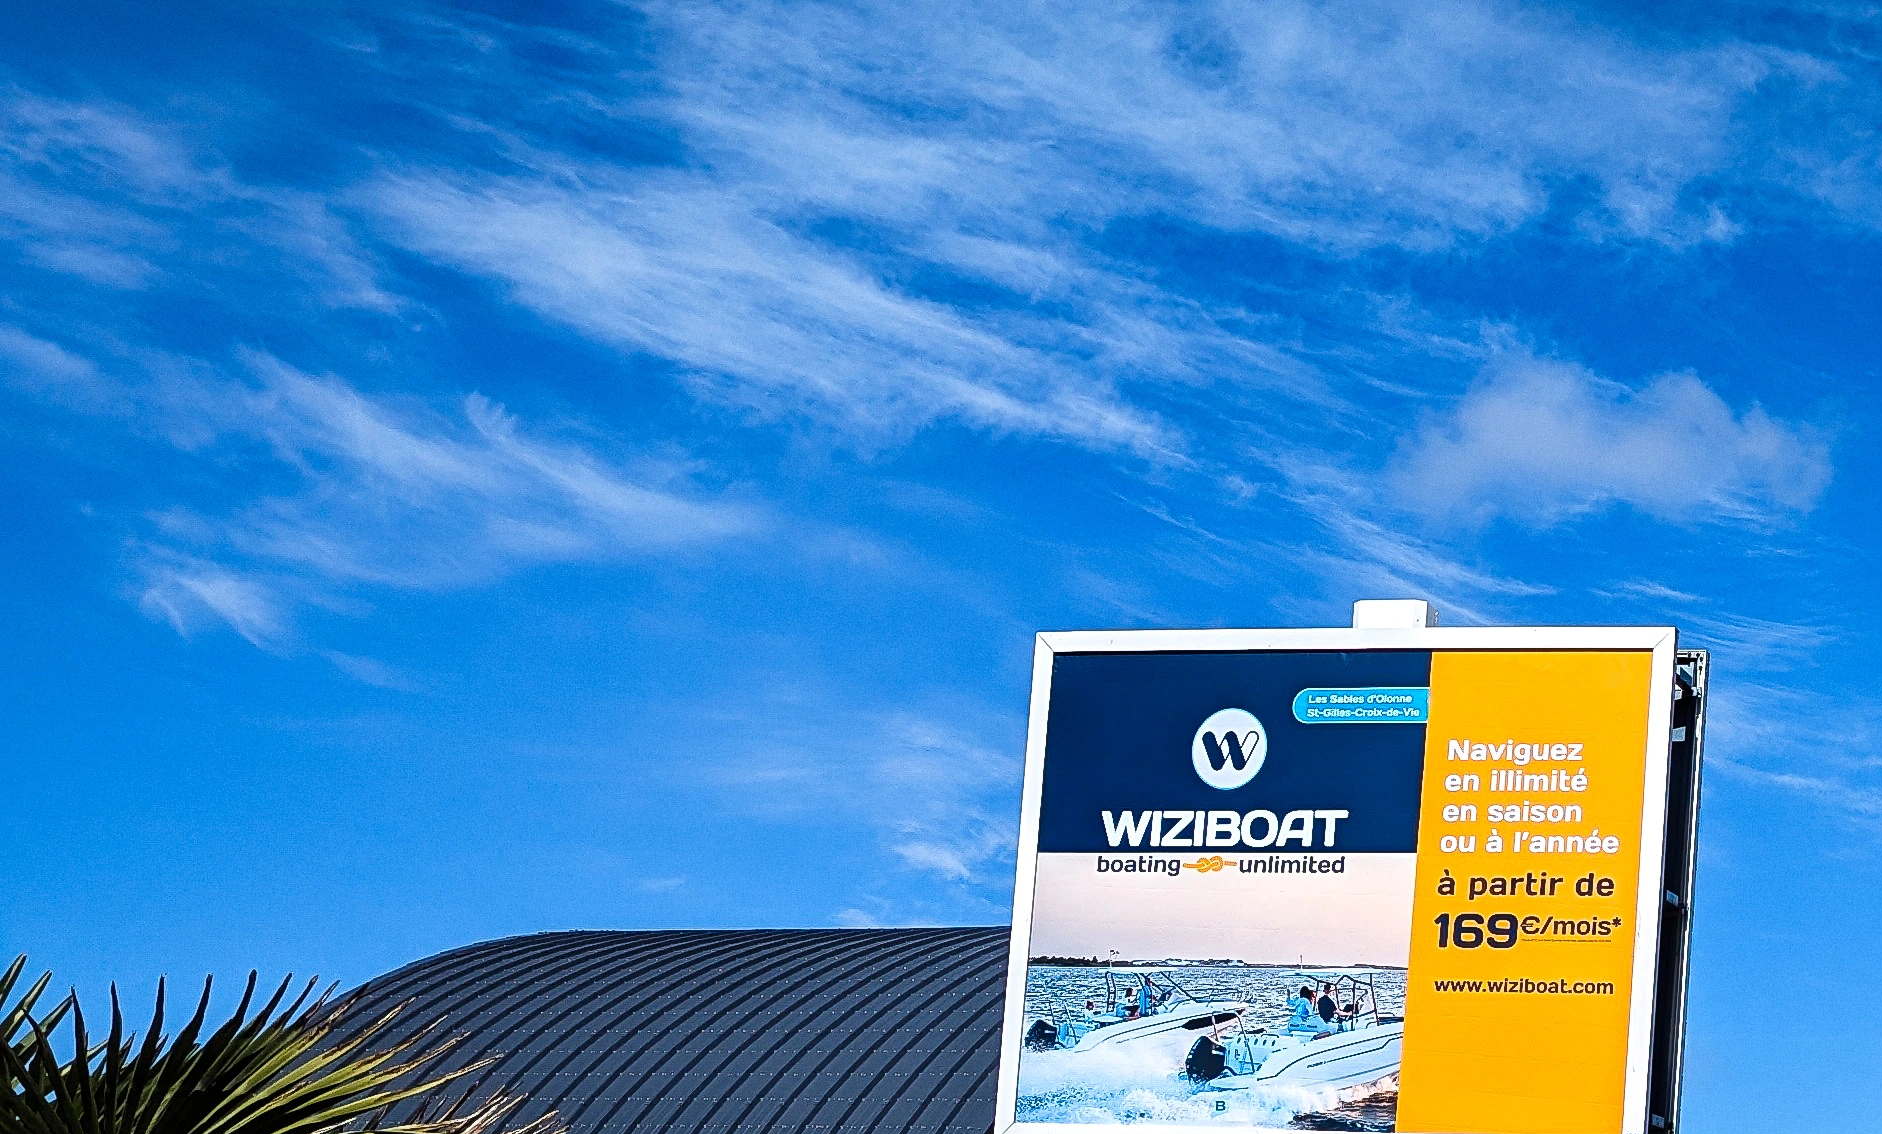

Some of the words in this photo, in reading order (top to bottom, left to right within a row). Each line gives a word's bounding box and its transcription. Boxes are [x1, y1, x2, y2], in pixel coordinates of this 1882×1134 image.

[1308, 694, 1327, 704] Les
[1329, 694, 1364, 704] Sables
[1366, 694, 1412, 704] d'Olonne
[1447, 739, 1584, 766] Naviguez
[1444, 773, 1480, 792] en
[1489, 768, 1588, 792] illimité
[1442, 804, 1477, 822] en
[1487, 800, 1582, 822] saison
[1101, 809, 1349, 847] WIZIBOAT
[1440, 834, 1476, 853] ou
[1485, 829, 1503, 853] à
[1513, 829, 1620, 854] l'année
[1096, 856, 1181, 876] boating
[1239, 856, 1345, 875] unlimited
[1437, 869, 1455, 896] à
[1468, 871, 1564, 901] partir
[1575, 872, 1615, 897] de
[1434, 978, 1614, 995] www.wiziboat.com
